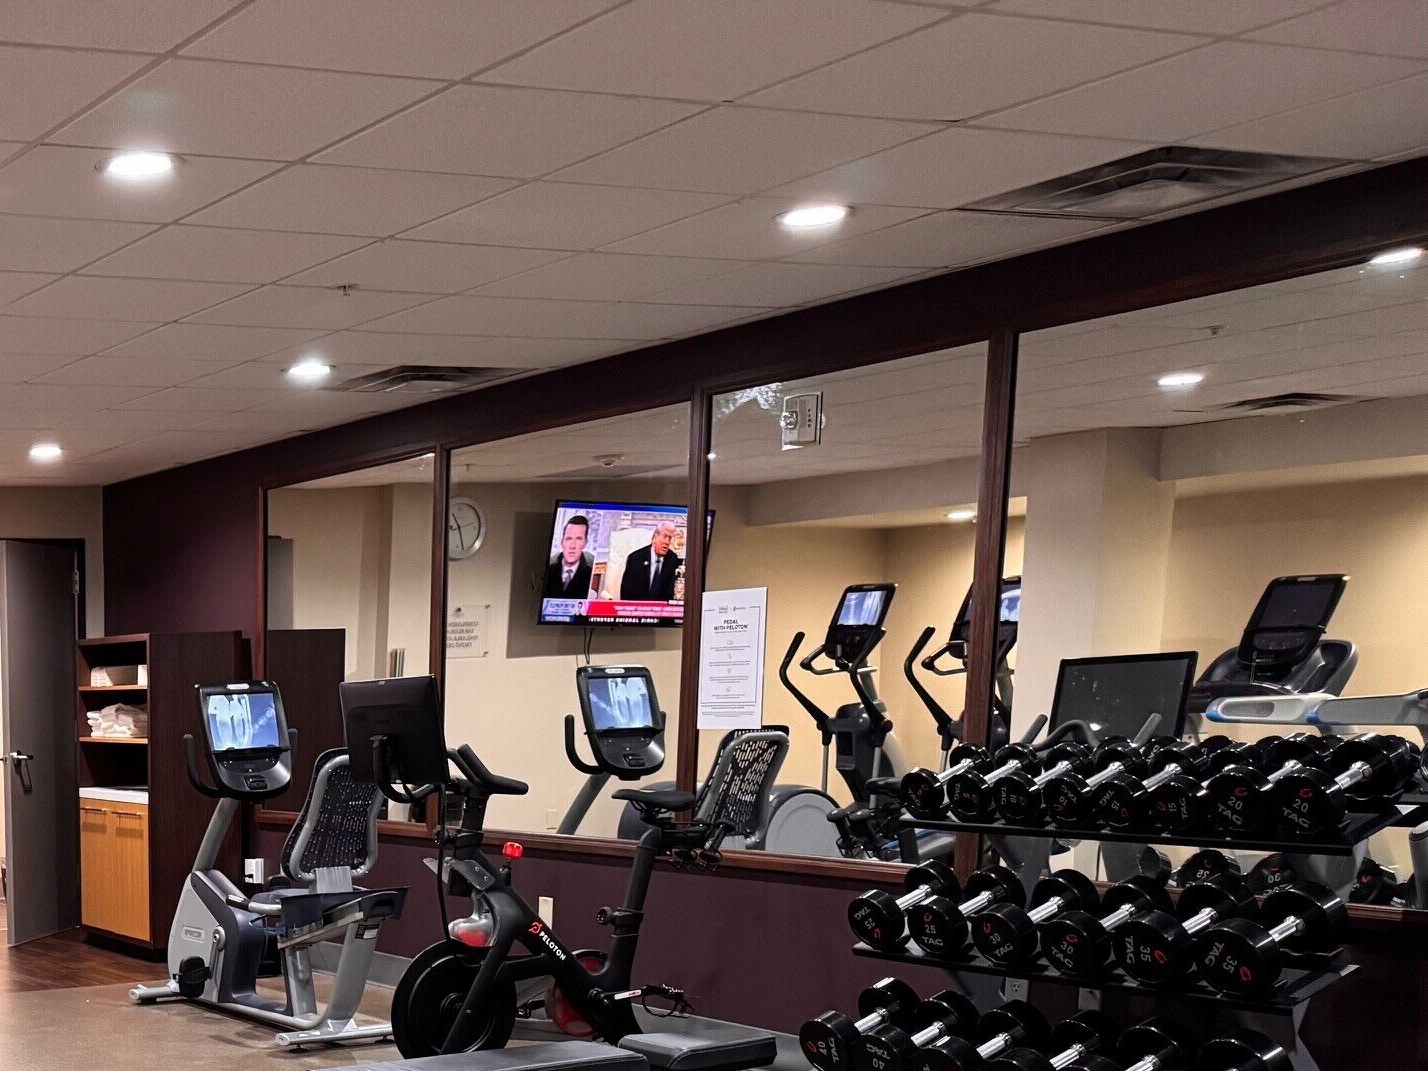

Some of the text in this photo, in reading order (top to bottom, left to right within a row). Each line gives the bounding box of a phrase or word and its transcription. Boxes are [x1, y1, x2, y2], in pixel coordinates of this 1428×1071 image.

[1227, 796, 1243, 811] 20
[1292, 799, 1309, 813] 20
[1217, 804, 1244, 825] TAG
[1282, 807, 1311, 828] TAG
[854, 906, 871, 920] TAG
[865, 918, 876, 930] 25
[924, 924, 936, 934] 25
[539, 931, 566, 961] PELOTON
[922, 936, 943, 947] TAG
[990, 933, 1001, 945] 30
[993, 943, 1014, 957] TAG
[1060, 941, 1074, 954] 30
[1124, 936, 1135, 965] TAG
[1139, 945, 1151, 963] 35
[1204, 941, 1224, 967] TAG
[1050, 946, 1074, 969] TAG
[1222, 955, 1237, 974] 35
[817, 1041, 827, 1056] 40
[828, 1037, 839, 1063] TAG
[866, 1042, 891, 1061] TAG
[872, 1057, 885, 1070] 40
